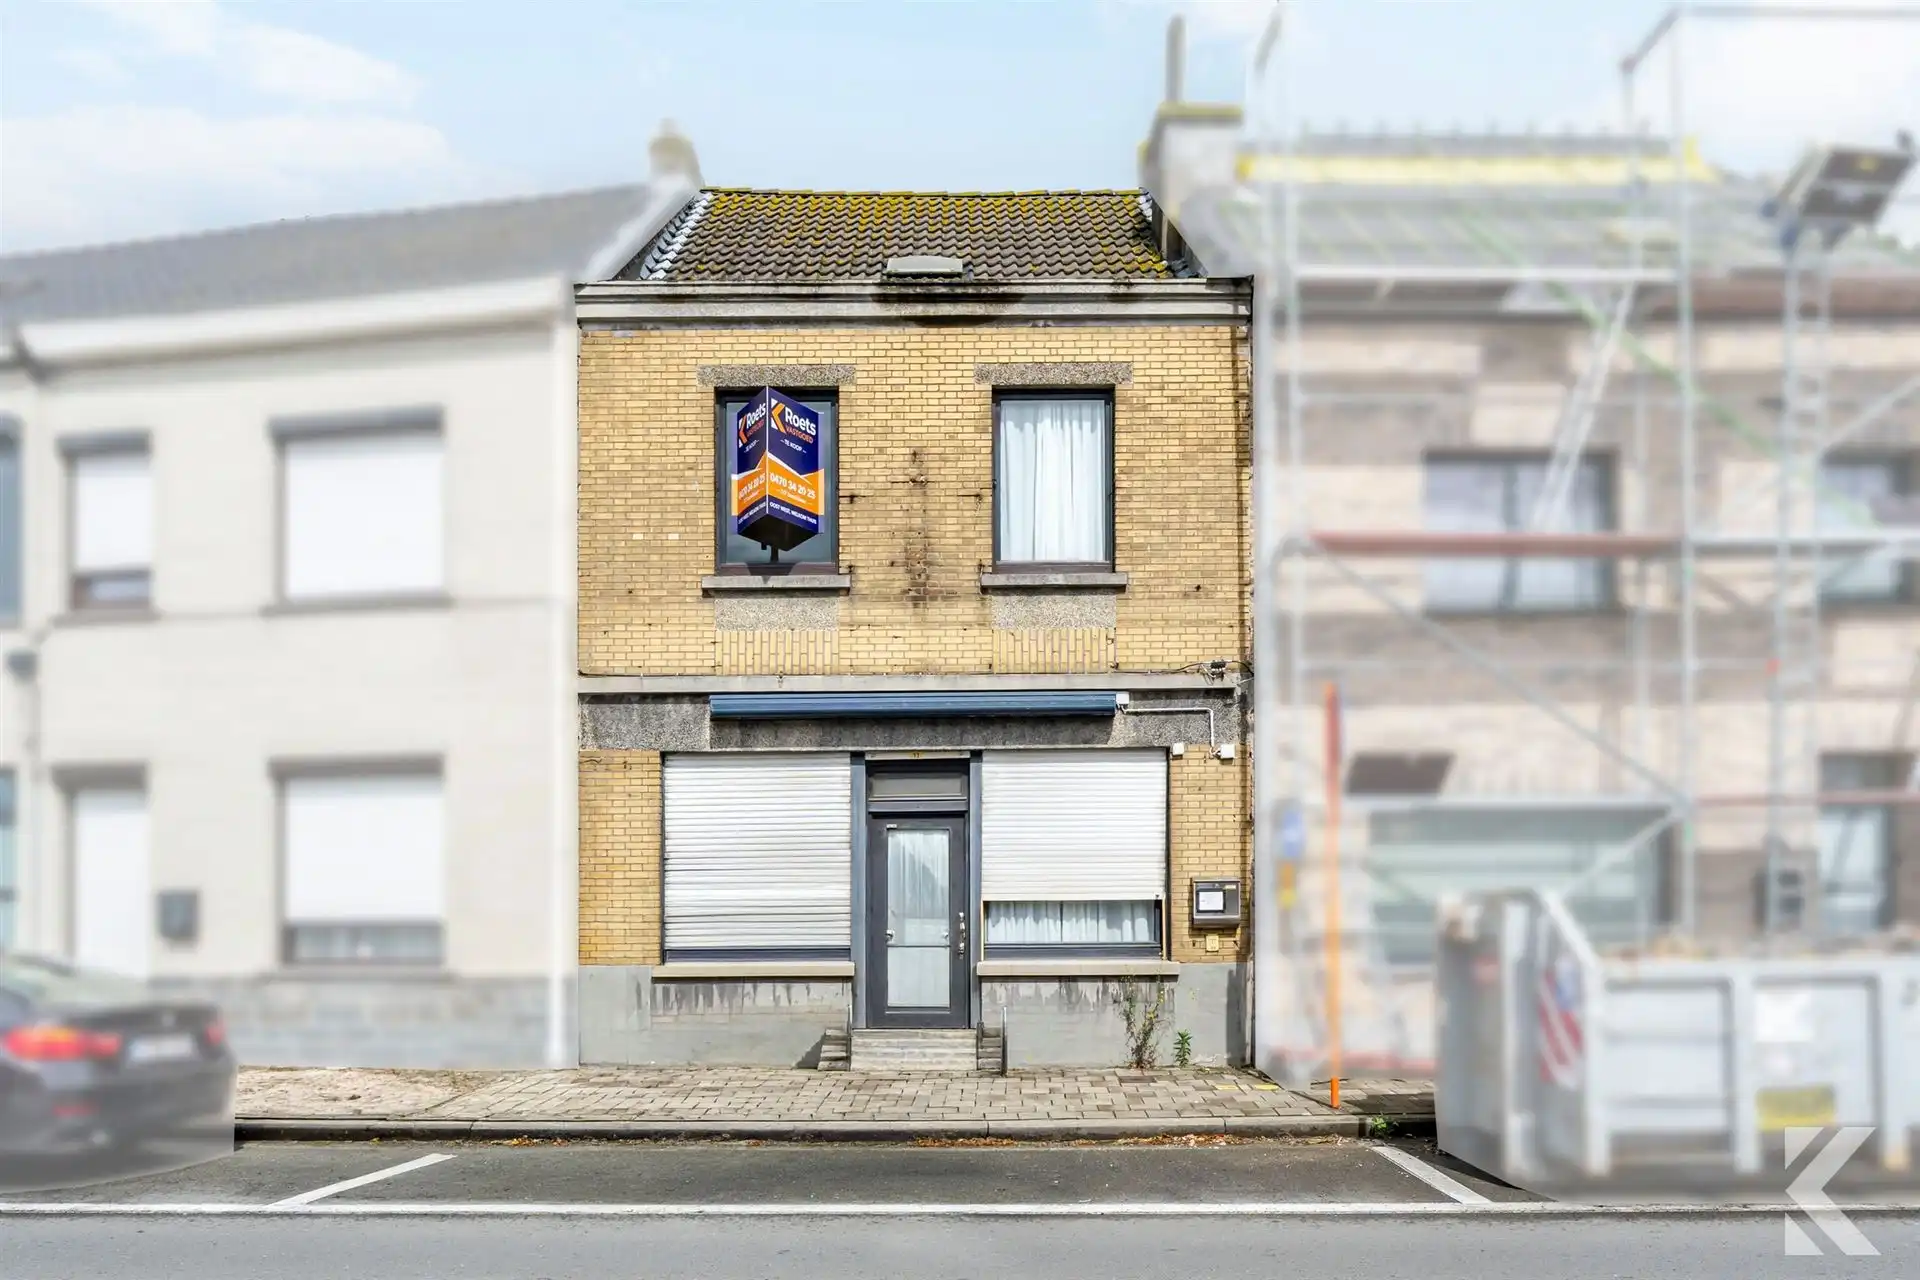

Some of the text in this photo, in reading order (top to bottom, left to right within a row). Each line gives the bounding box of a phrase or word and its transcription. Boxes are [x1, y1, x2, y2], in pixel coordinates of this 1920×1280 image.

[746, 402, 766, 429] Roets
[785, 406, 817, 436] Roets
[769, 472, 788, 487] 0470
[788, 480, 797, 492] 34
[797, 485, 807, 496] 20
[807, 489, 816, 500] 25
